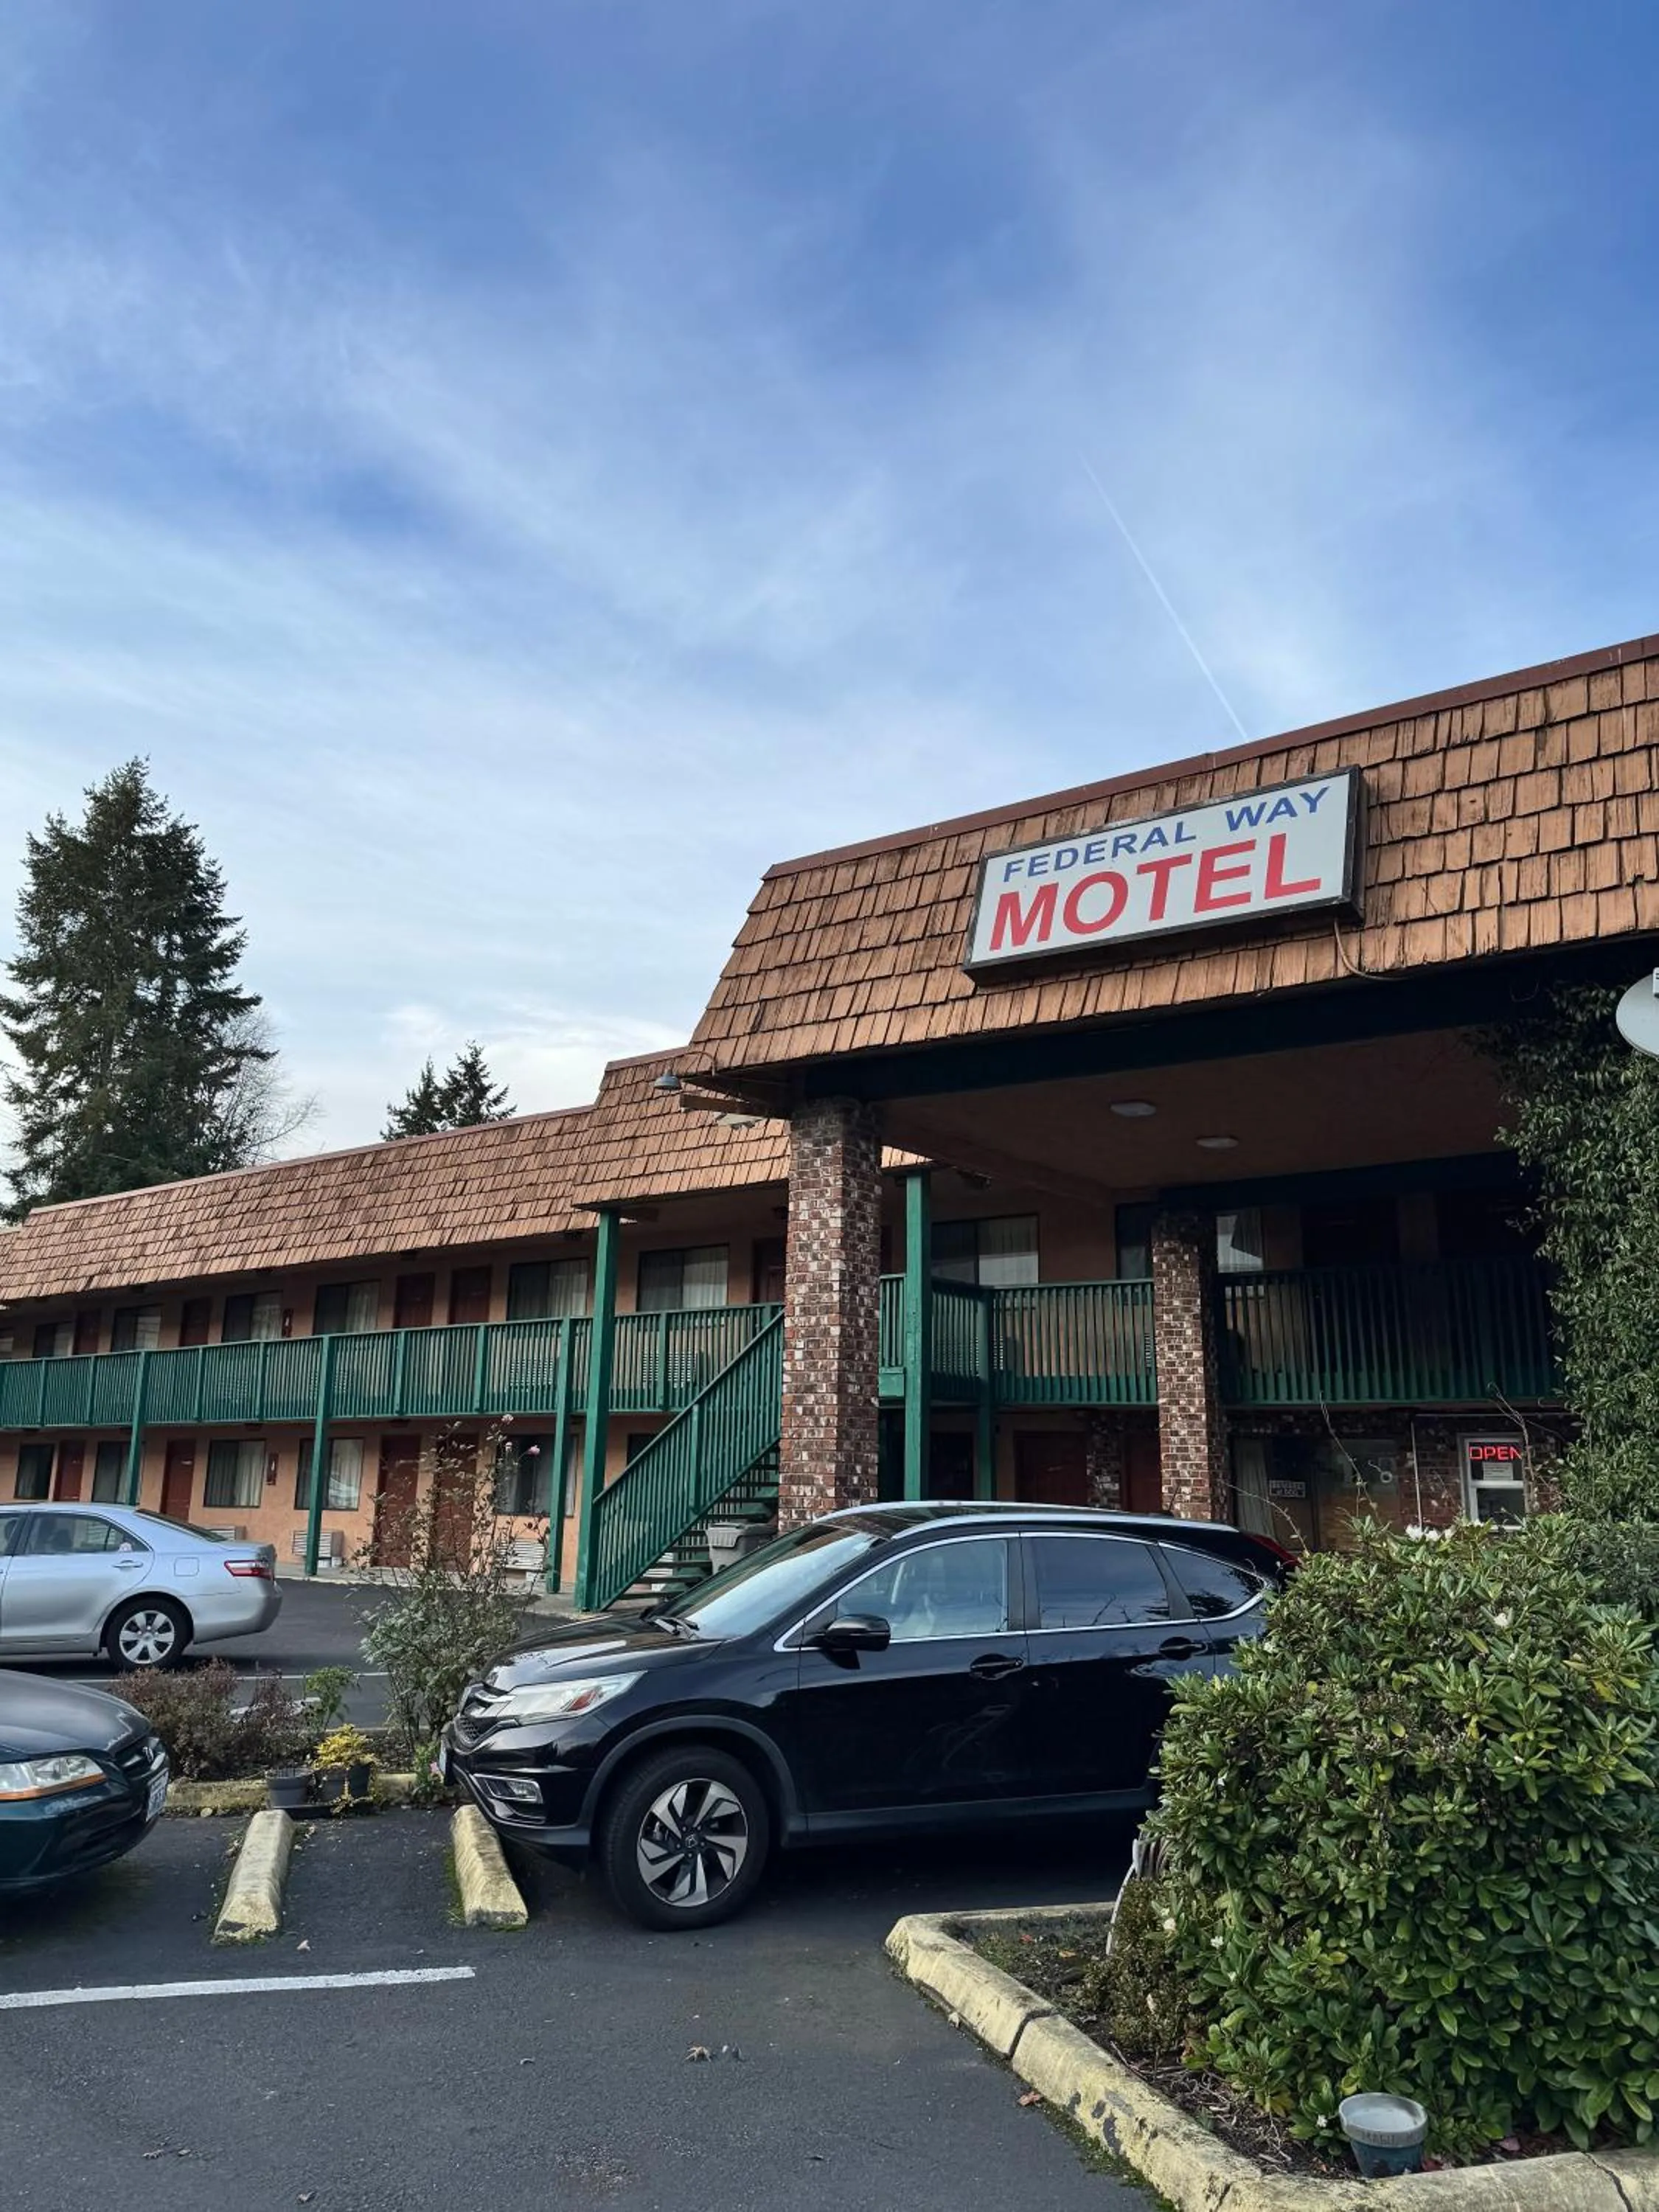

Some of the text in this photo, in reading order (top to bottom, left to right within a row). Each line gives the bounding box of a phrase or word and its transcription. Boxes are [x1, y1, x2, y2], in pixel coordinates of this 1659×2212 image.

[1003, 786, 1329, 883] FEDERAL WAY
[990, 834, 1321, 950] MOTEL
[1469, 1445, 1523, 1461] OPEN
